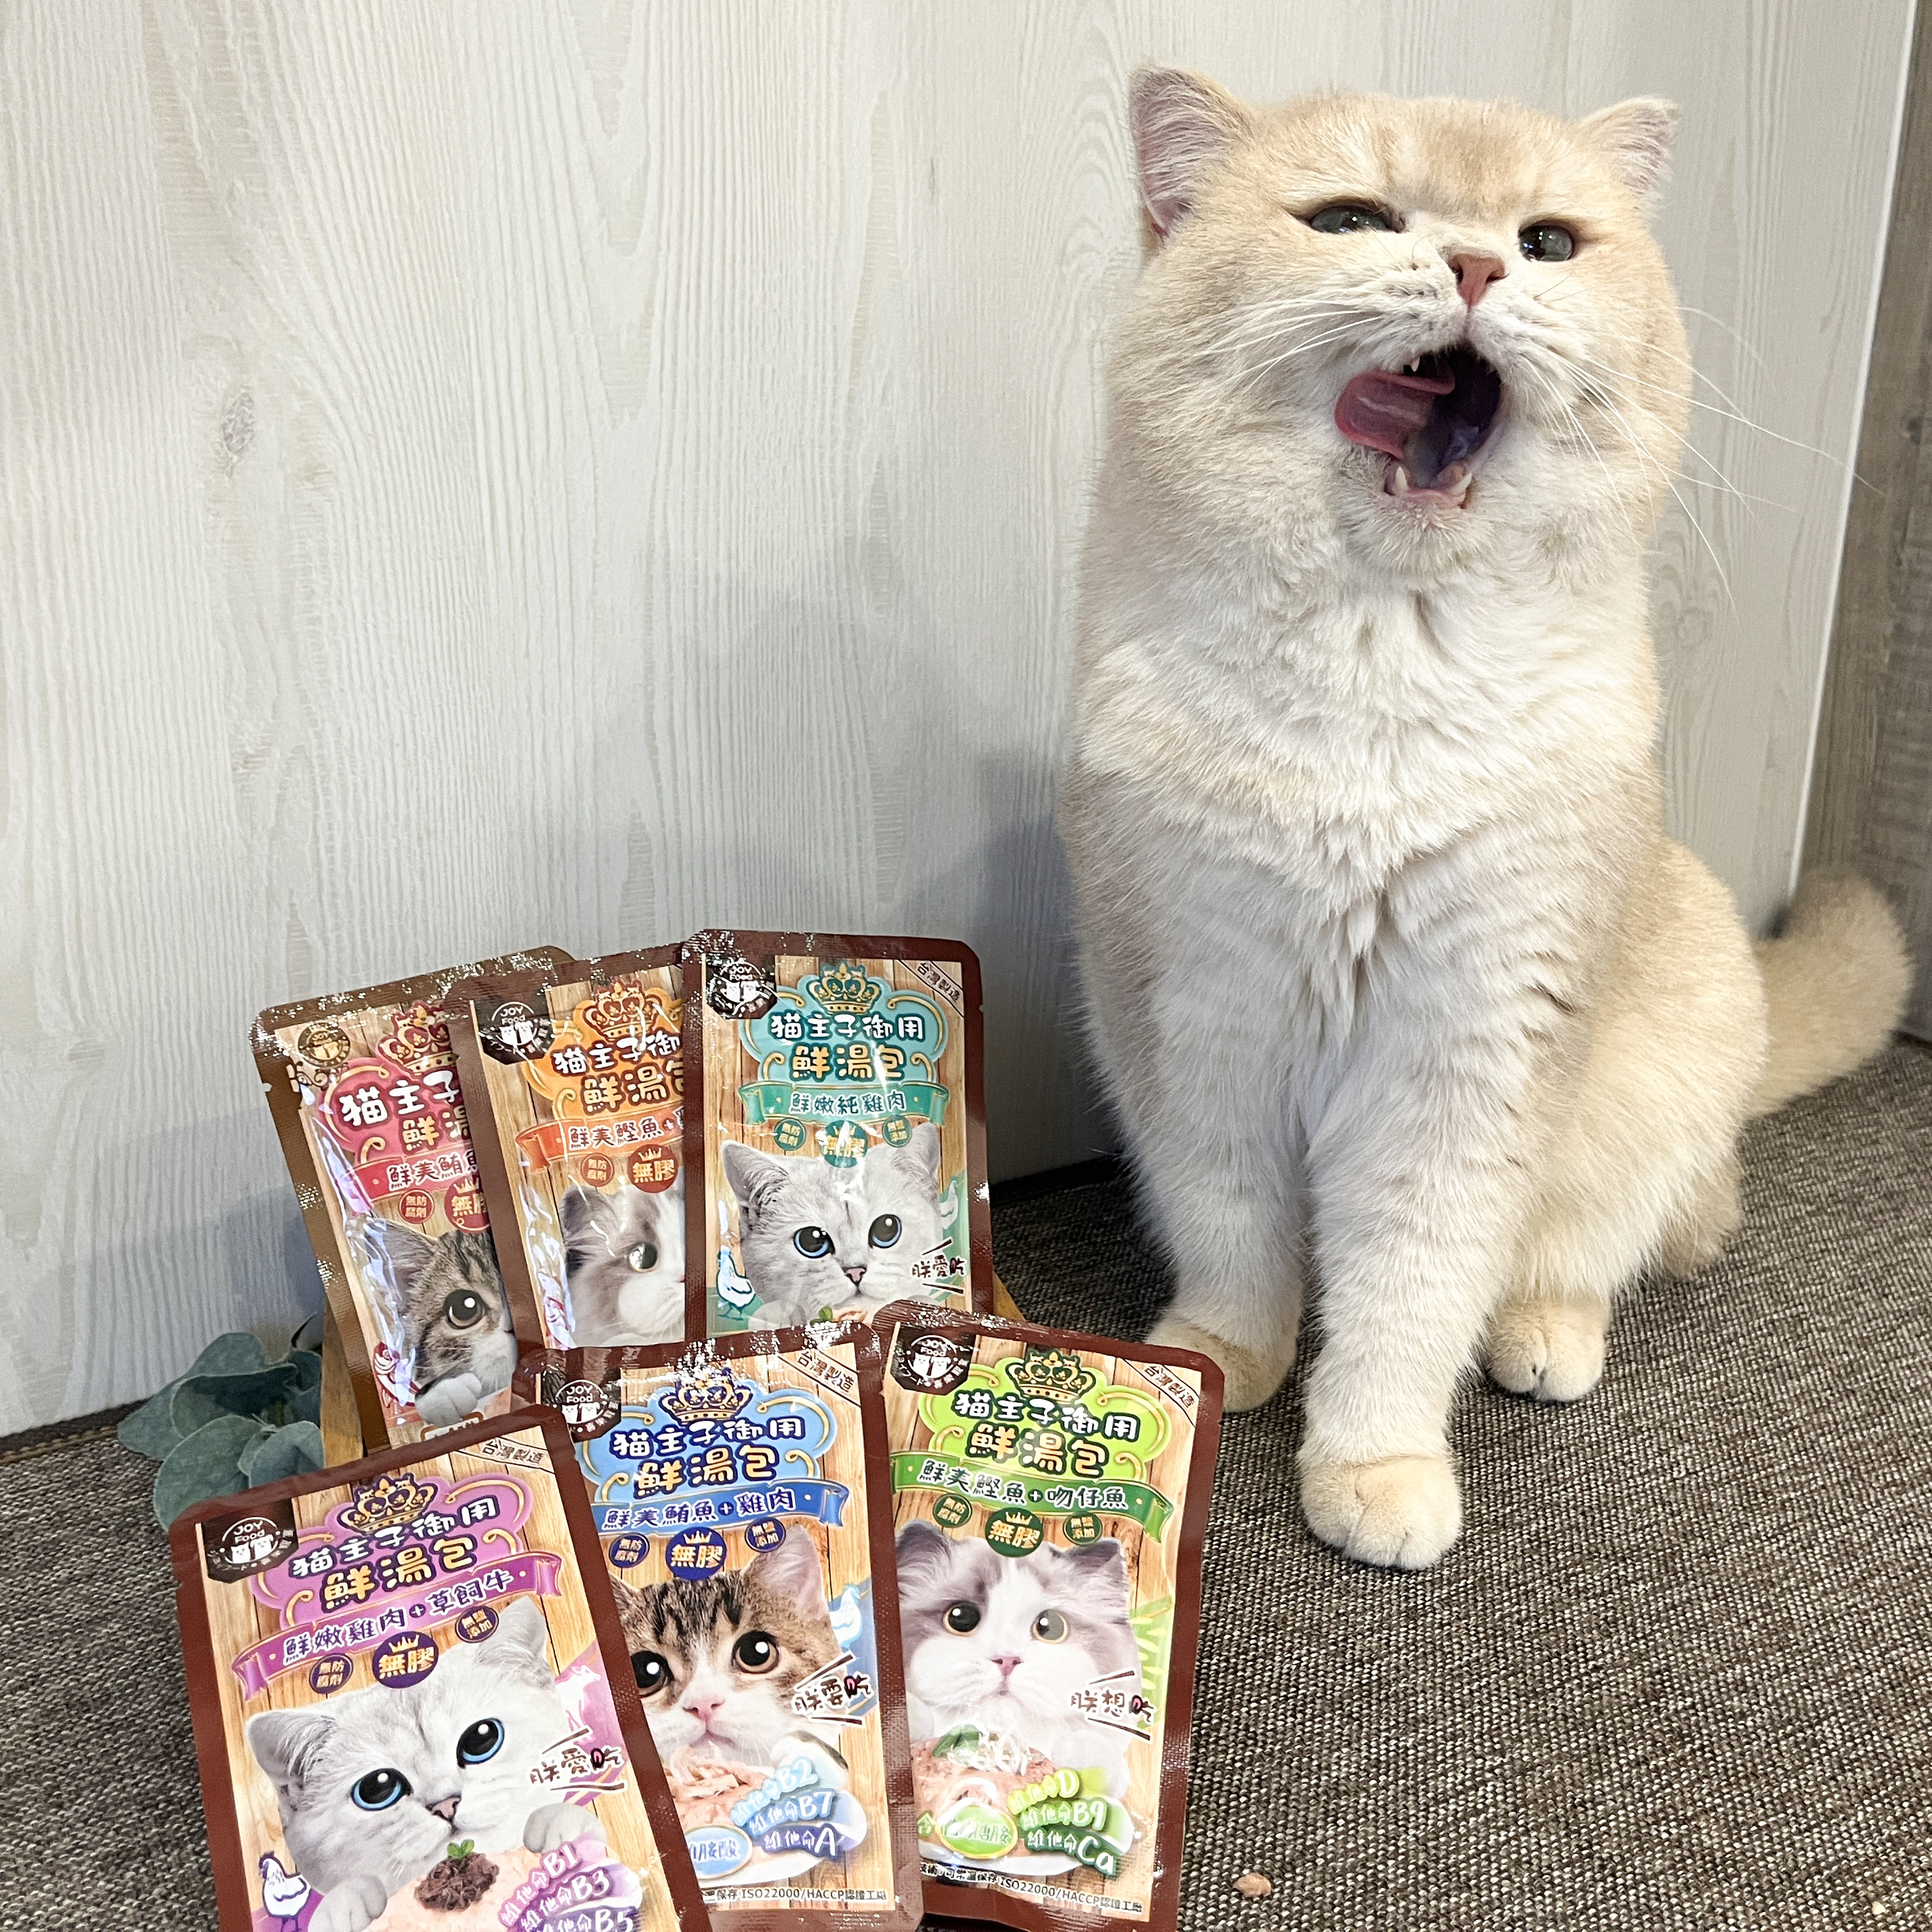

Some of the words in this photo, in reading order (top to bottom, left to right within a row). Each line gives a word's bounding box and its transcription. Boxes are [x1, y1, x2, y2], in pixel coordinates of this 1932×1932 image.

[500, 1005, 524, 1017] JOY
[501, 1014, 526, 1025] Food
[792, 1044, 904, 1079] 鮮湯包
[791, 1091, 905, 1115] 鮮嫩純雞肉
[632, 1159, 675, 1183] 無膠
[920, 1346, 947, 1357] Food
[797, 1350, 855, 1393] 台灣製造
[566, 1385, 593, 1395] JOY
[566, 1392, 593, 1404] Food
[1145, 1366, 1195, 1408] 台灣製造
[482, 1439, 544, 1464] 台灣製造
[969, 1422, 1108, 1476] 鮮湯包
[637, 1447, 775, 1496] 鮮湯包
[233, 1520, 263, 1536] JOY
[235, 1529, 265, 1544] Food
[989, 1518, 1040, 1550] 無膠
[671, 1545, 724, 1568] 無膠
[325, 1537, 473, 1610] 鮮湯包
[379, 1646, 435, 1680] 無膠
